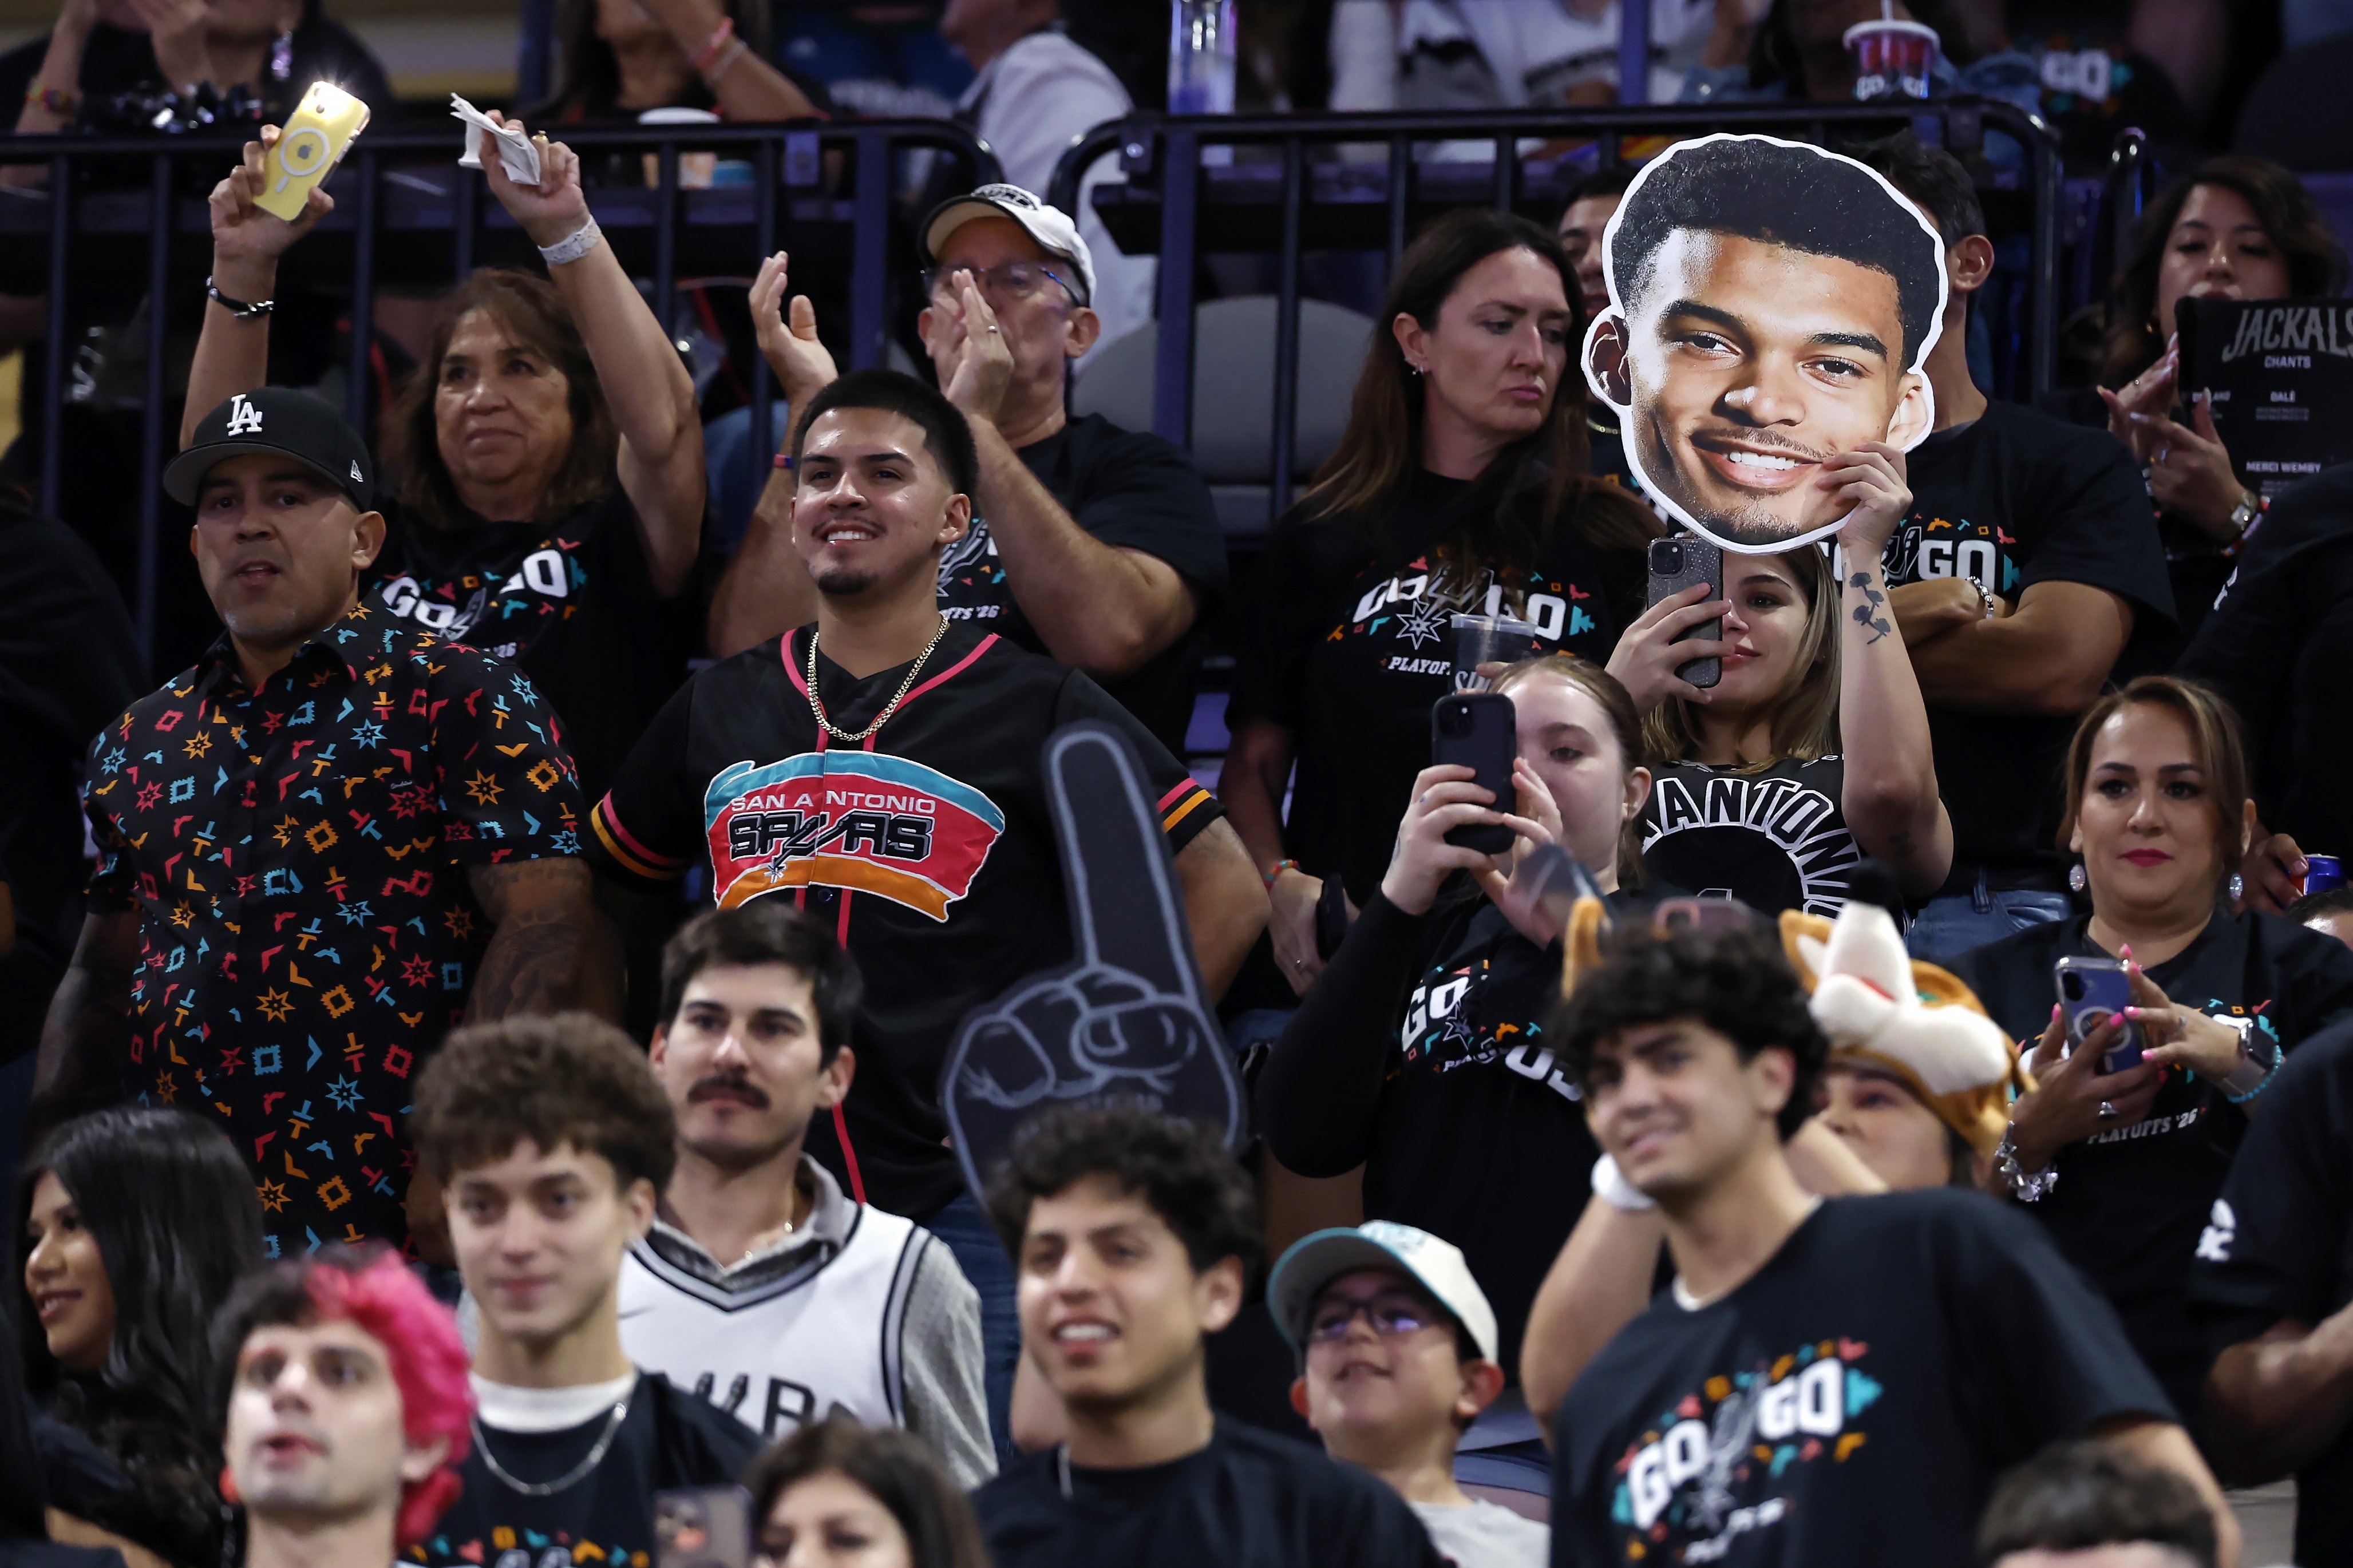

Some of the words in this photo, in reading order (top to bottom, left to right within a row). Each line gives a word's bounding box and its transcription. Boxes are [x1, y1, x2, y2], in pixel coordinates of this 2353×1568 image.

[2264, 355, 2311, 369] CHANTS
[227, 394, 262, 436] LA
[2247, 461, 2279, 472] MERCI
[2281, 462, 2321, 473] WEMBY
[1918, 539, 1996, 594] GO
[1387, 656, 1451, 676] PLAYOF
[731, 794, 786, 812] SAN
[727, 808, 935, 884] SPURS
[1628, 1418, 1710, 1531] GO
[1756, 1356, 1844, 1440] GO
